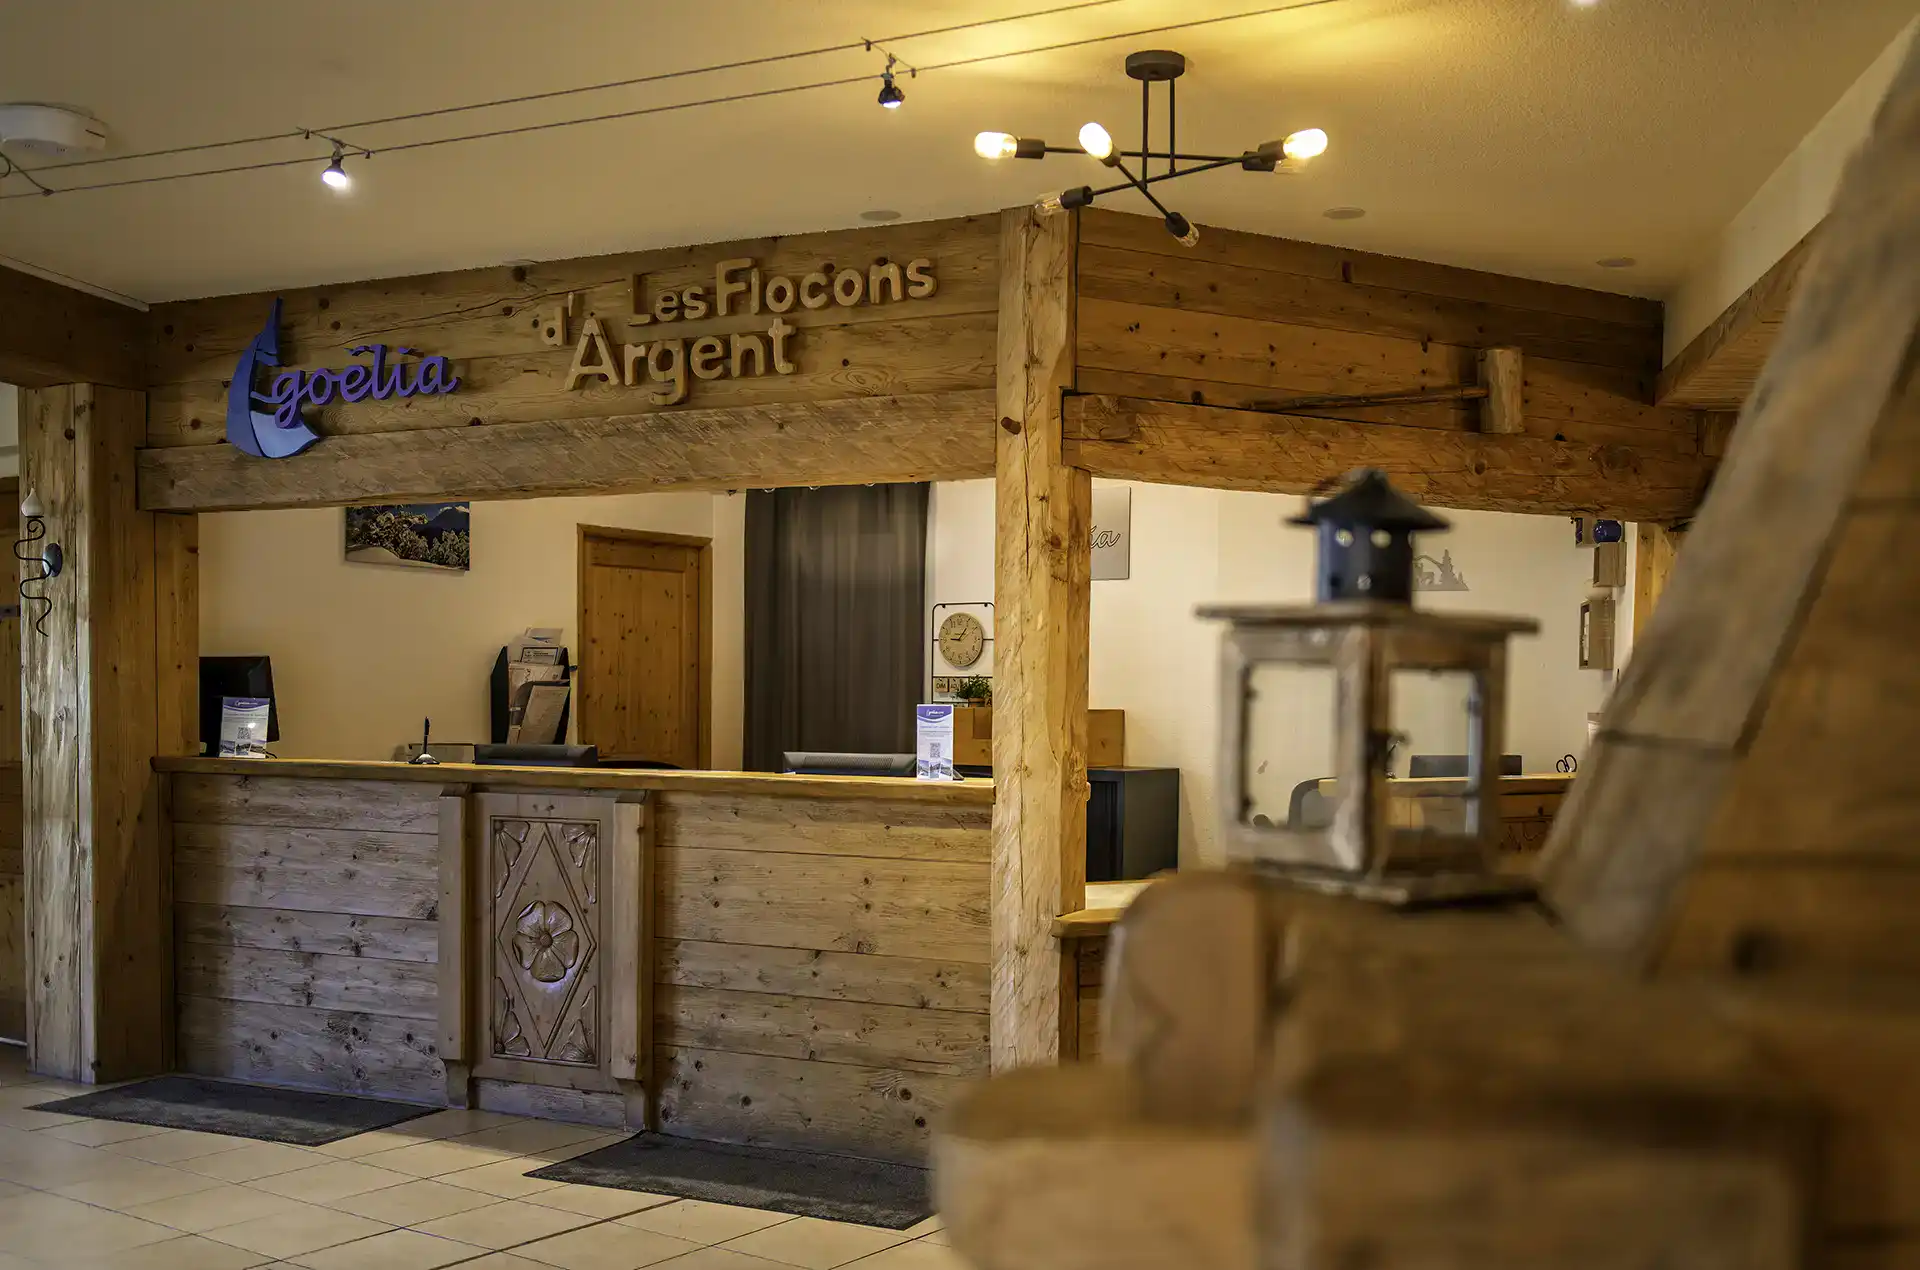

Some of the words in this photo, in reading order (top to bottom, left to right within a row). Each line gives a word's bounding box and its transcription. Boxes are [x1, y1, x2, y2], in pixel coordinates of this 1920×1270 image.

[627, 272, 708, 326] Les
[716, 257, 938, 317] Flocons
[564, 316, 798, 406] Argent
